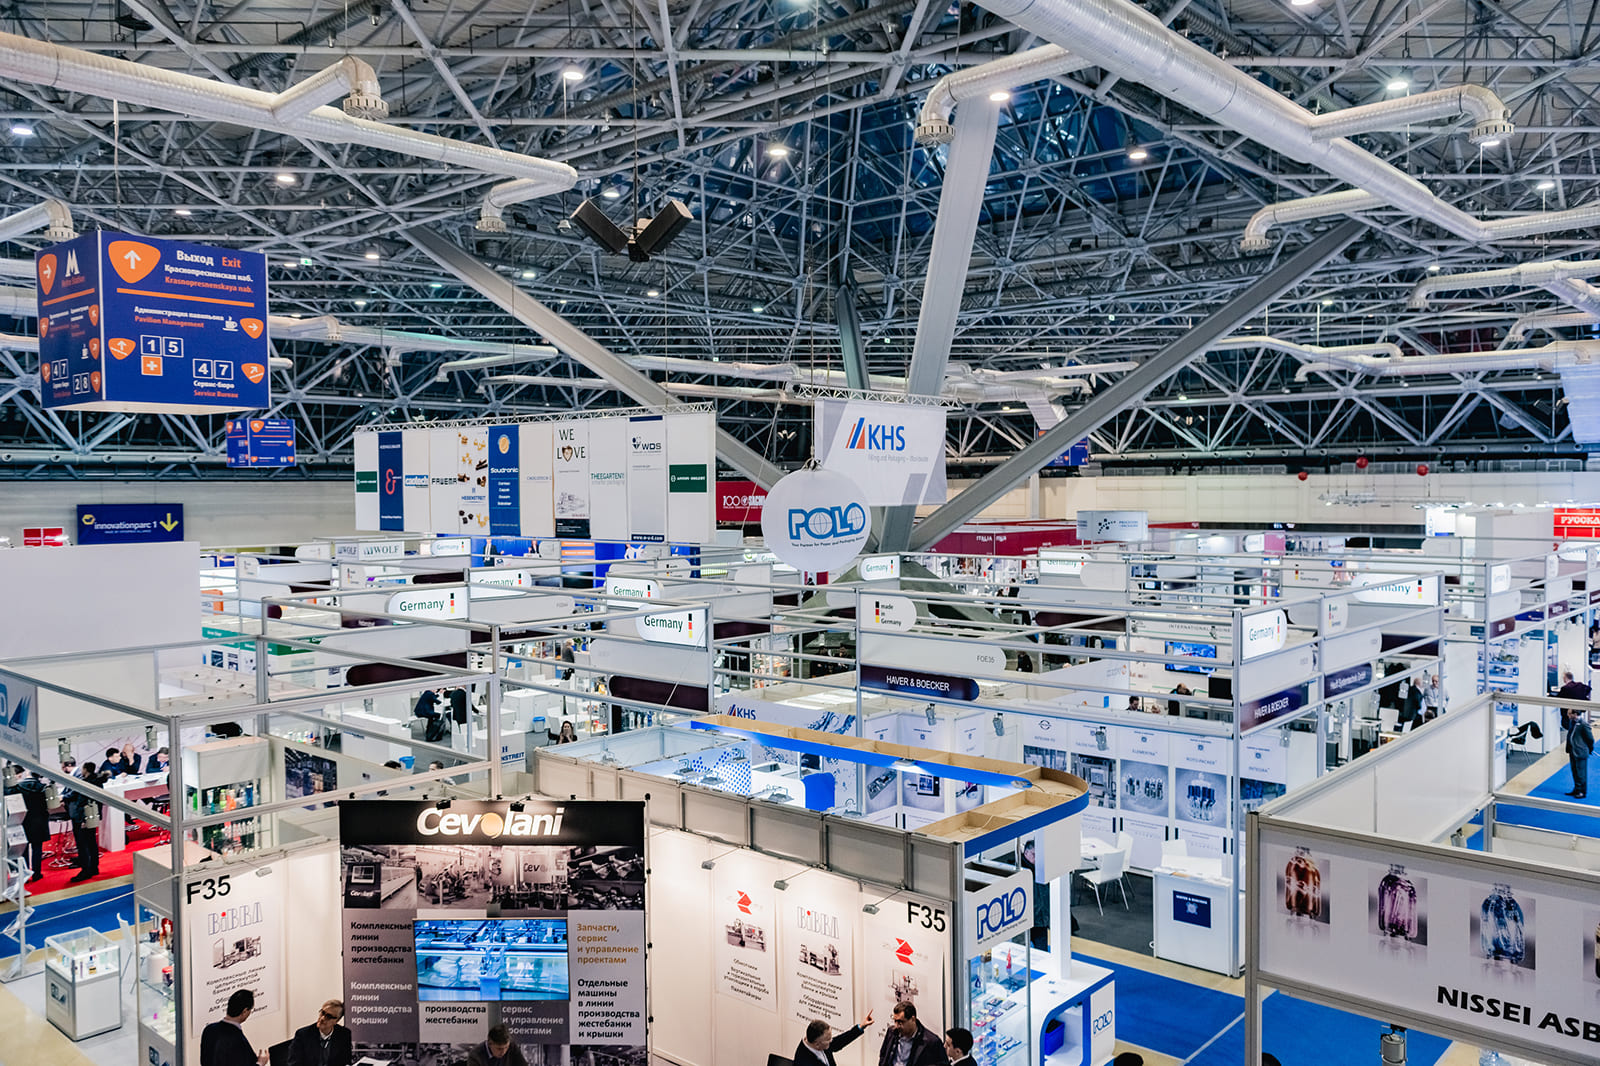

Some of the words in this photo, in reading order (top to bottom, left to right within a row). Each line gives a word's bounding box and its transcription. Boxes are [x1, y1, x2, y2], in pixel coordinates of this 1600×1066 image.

[176, 250, 214, 266] Выход
[222, 256, 241, 268] Exit
[147, 340, 155, 352] 1
[168, 341, 178, 353] 5
[198, 363, 208, 374] 4
[219, 364, 228, 376] 7
[558, 428, 574, 440] WE
[868, 424, 905, 451] KHS
[788, 502, 866, 540] POLO
[374, 545, 398, 554] WOLF
[866, 563, 888, 573] Germany
[613, 586, 644, 597] Germany
[400, 600, 444, 611] Germany
[644, 614, 683, 632] Germany
[881, 618, 901, 626] Germany
[1250, 627, 1274, 641] Germany
[886, 675, 908, 686] HAVER
[910, 678, 915, 686] &
[916, 679, 950, 691] BOECKER
[738, 707, 756, 720] KHS
[417, 807, 565, 839] Cevolani
[186, 875, 231, 904] F35
[907, 901, 946, 932] F35
[977, 887, 1026, 940] POLO
[351, 922, 412, 931] Комплексные
[577, 924, 619, 933] Запчасти,
[577, 935, 608, 943] сервис
[351, 945, 412, 953] производства
[585, 946, 639, 954] управление
[351, 956, 404, 964] жестебанки
[351, 982, 412, 991] Комплексные
[578, 979, 628, 988] Отдельные
[351, 1005, 412, 1014] производства
[425, 1005, 486, 1014] производства
[502, 1006, 533, 1014] сервис
[578, 1010, 640, 1018] производства
[1437, 986, 1531, 1026] NISSEI
[1538, 1012, 1600, 1043] ASB
[351, 1017, 388, 1025] крышки
[425, 1015, 478, 1024] жестебанки
[510, 1017, 564, 1025] управление
[578, 1019, 632, 1028] жестебанки
[1093, 1010, 1112, 1034] POLO
[509, 1027, 552, 1036] роектами
